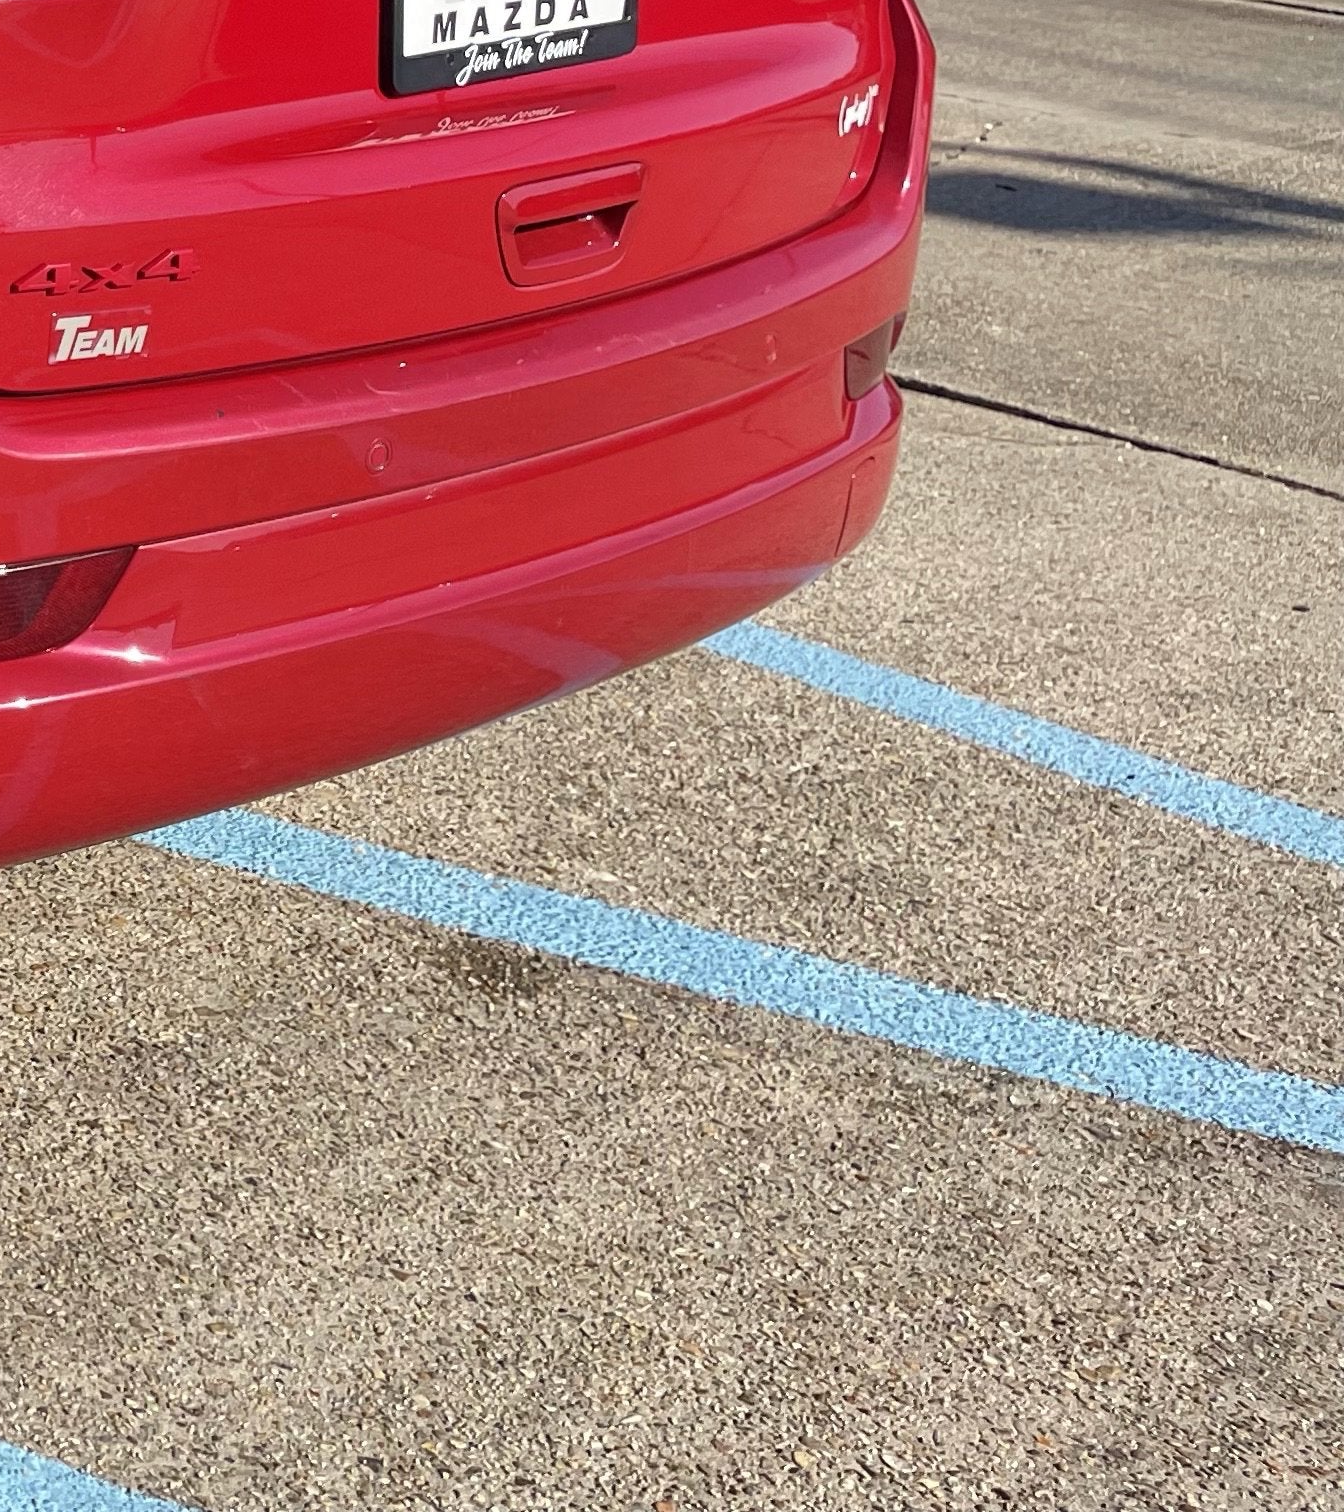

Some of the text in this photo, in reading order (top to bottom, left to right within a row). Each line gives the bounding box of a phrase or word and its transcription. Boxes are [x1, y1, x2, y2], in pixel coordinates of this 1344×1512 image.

[455, 28, 589, 87] Join The Team!
[54, 314, 149, 362] TEAM
